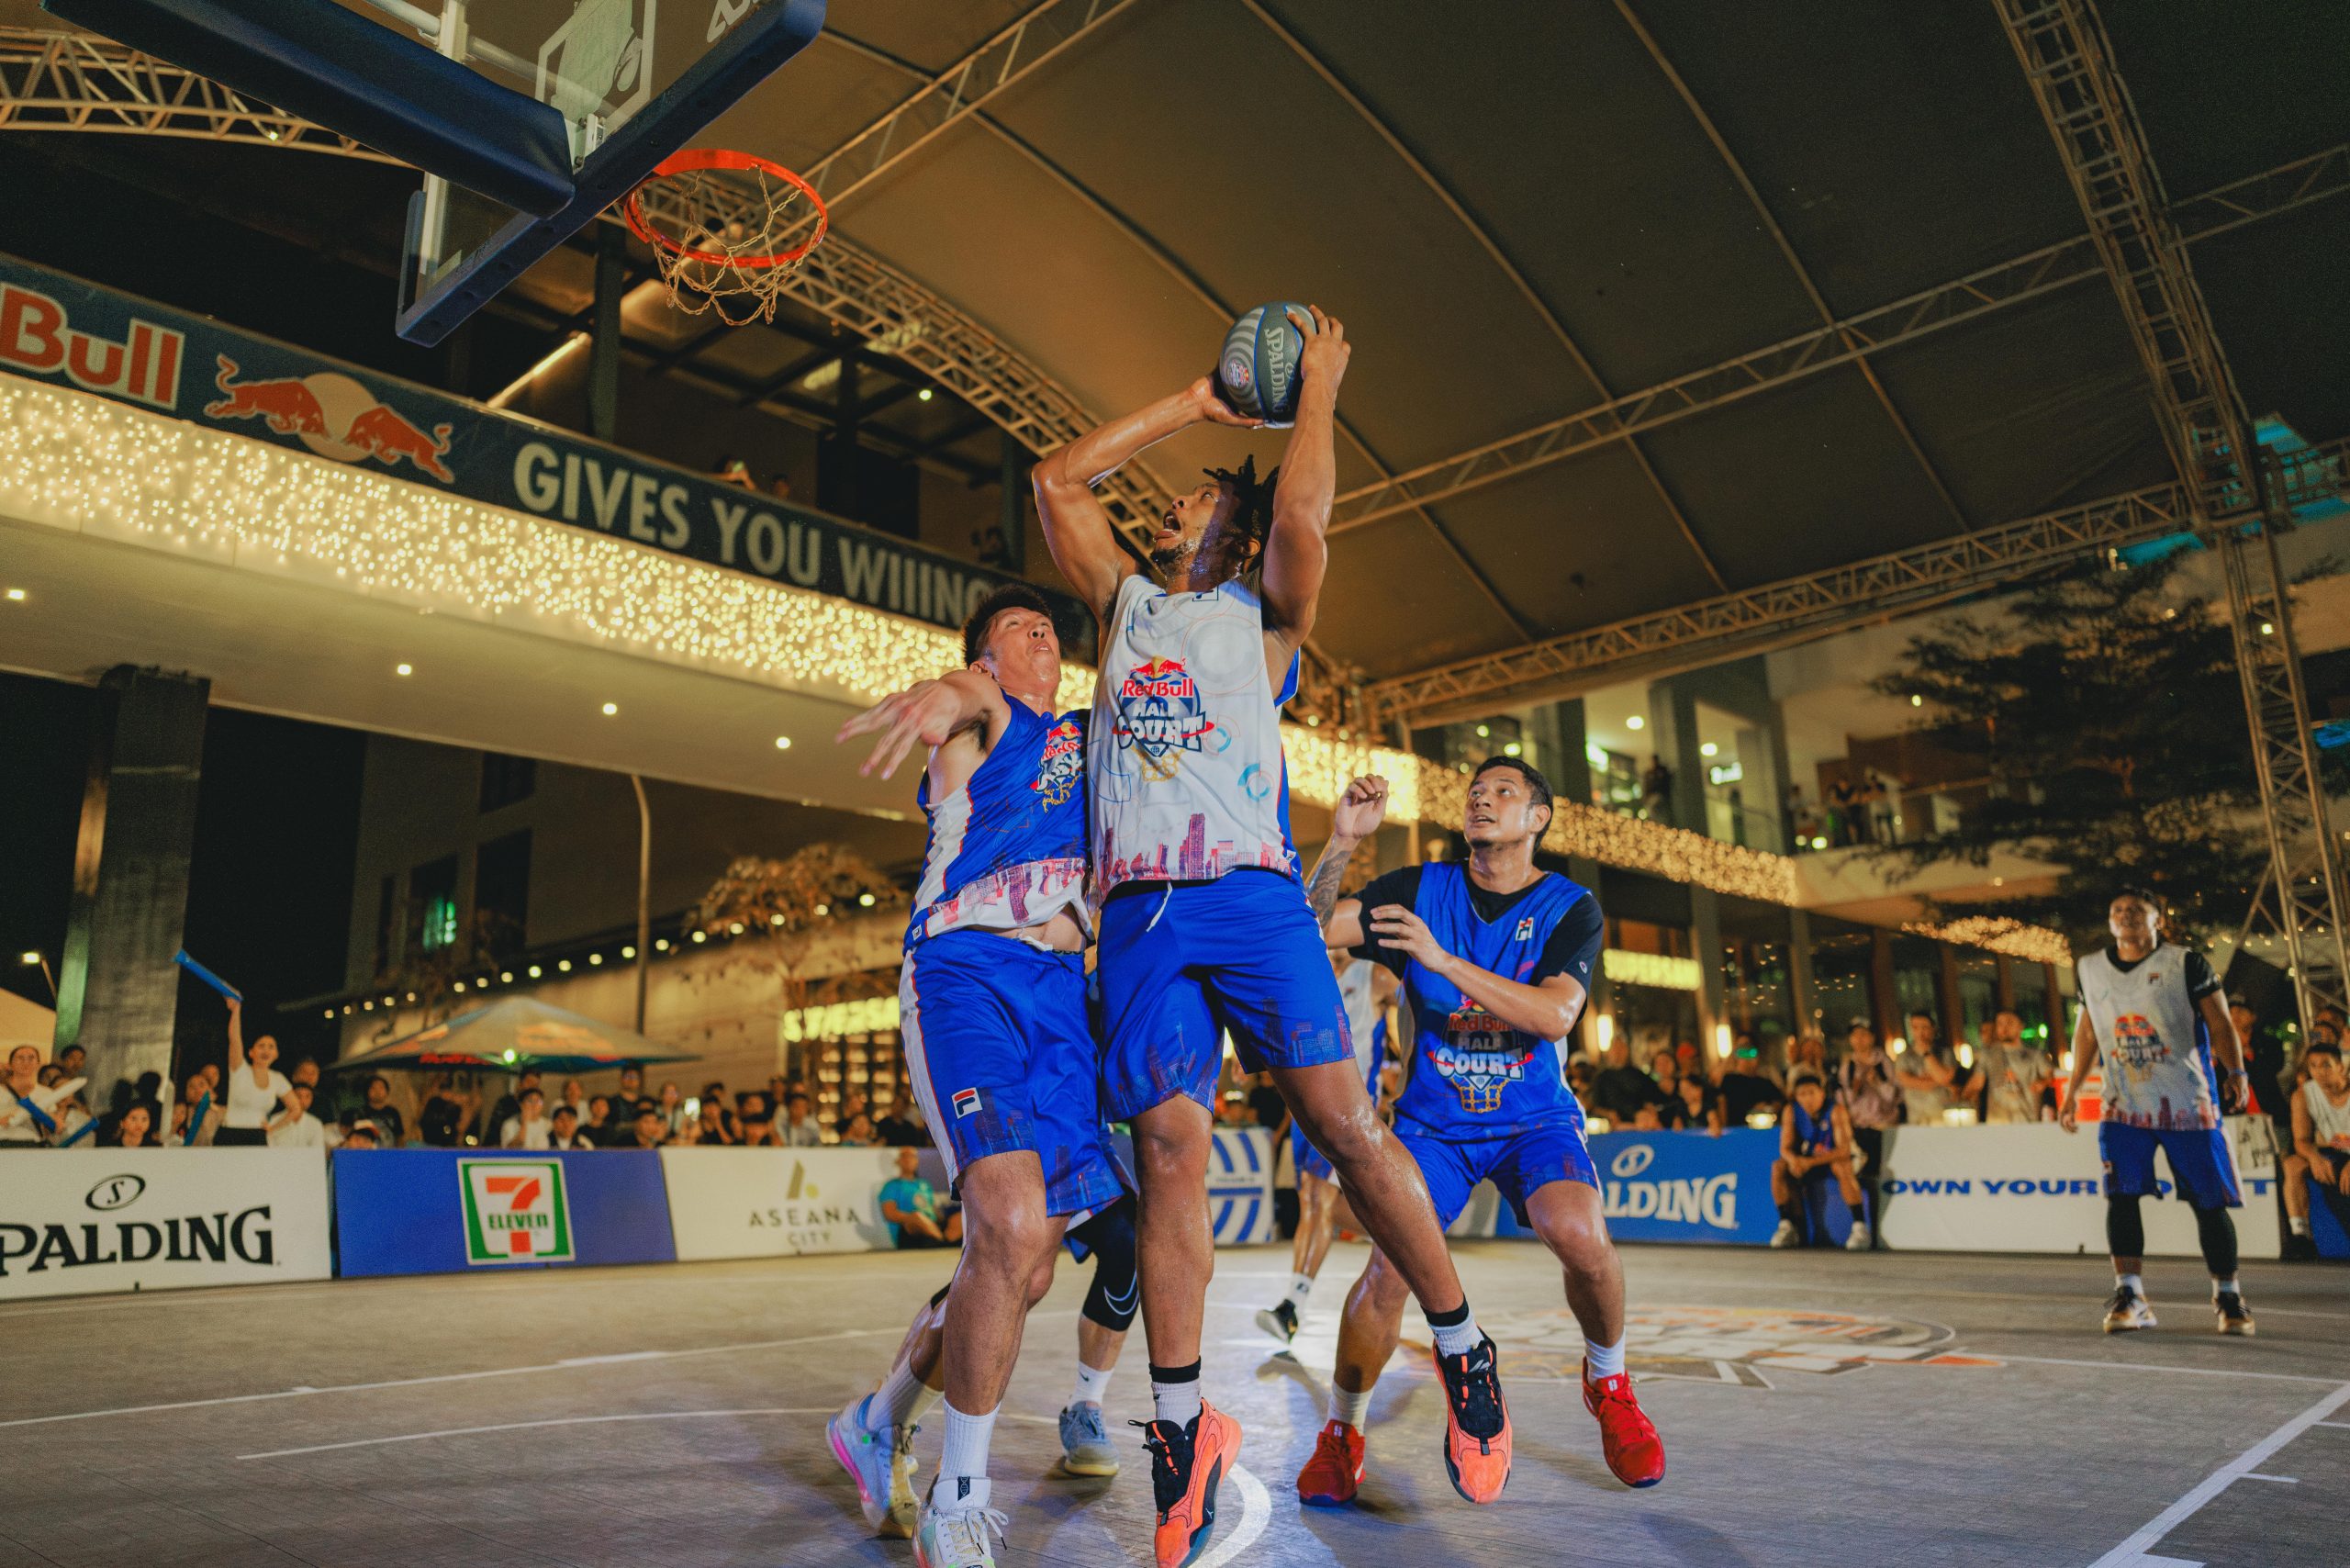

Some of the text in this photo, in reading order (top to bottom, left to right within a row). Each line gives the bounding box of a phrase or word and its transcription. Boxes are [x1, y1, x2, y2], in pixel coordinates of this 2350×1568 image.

[0, 286, 179, 404] Bull
[512, 442, 689, 549] GIVES
[711, 498, 821, 586] YOU
[1122, 678, 1193, 697] Red Bull
[1132, 701, 1181, 717] HALF
[1448, 1013, 1479, 1031] Red
[1457, 1036, 1502, 1050] HALF
[1434, 1044, 1525, 1081] COURT
[1882, 1180, 2098, 1195] OWN YOUR
[1601, 1172, 1738, 1230] LDING
[748, 1207, 861, 1227] ASEANA
[787, 1230, 831, 1247] CITY
